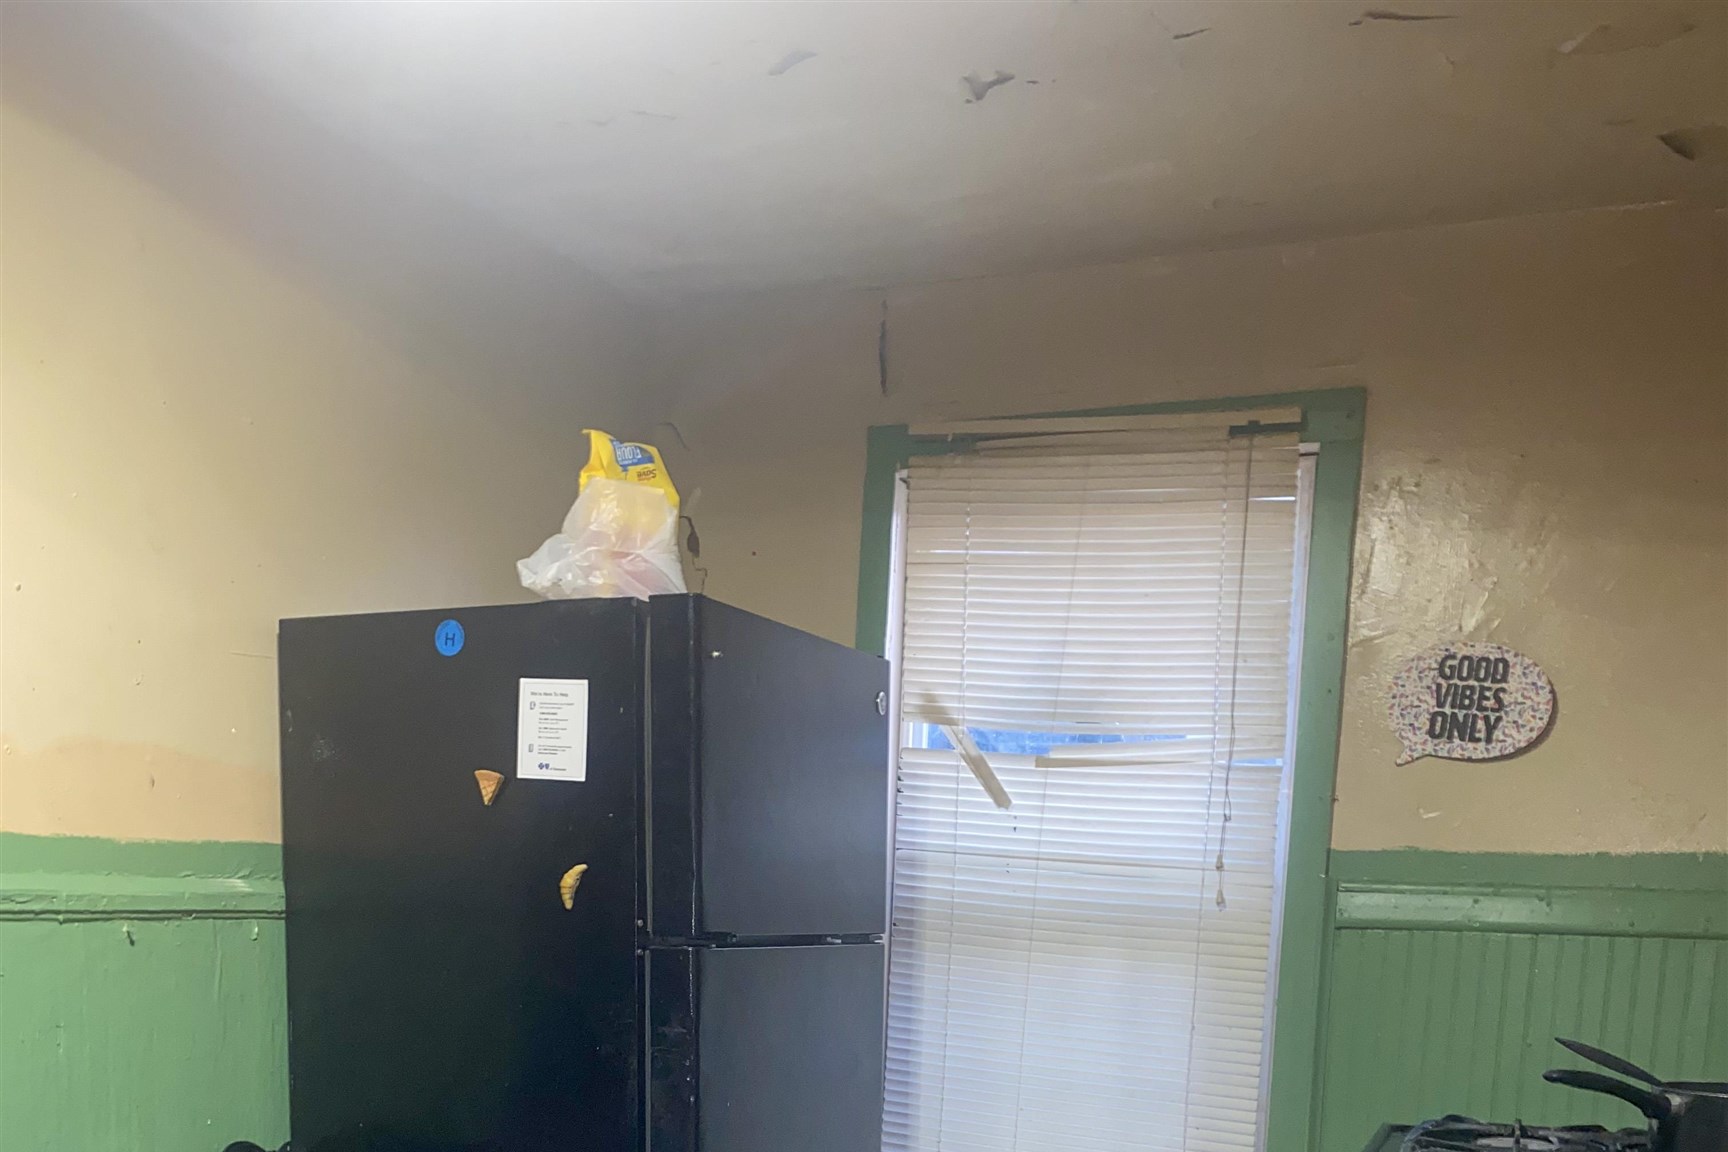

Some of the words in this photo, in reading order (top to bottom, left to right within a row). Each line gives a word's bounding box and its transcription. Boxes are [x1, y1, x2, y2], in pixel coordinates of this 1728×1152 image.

[444, 632, 456, 647] H
[1438, 654, 1510, 684] GOOD
[1435, 682, 1508, 712] VIBES
[1428, 710, 1503, 744] ONLY
